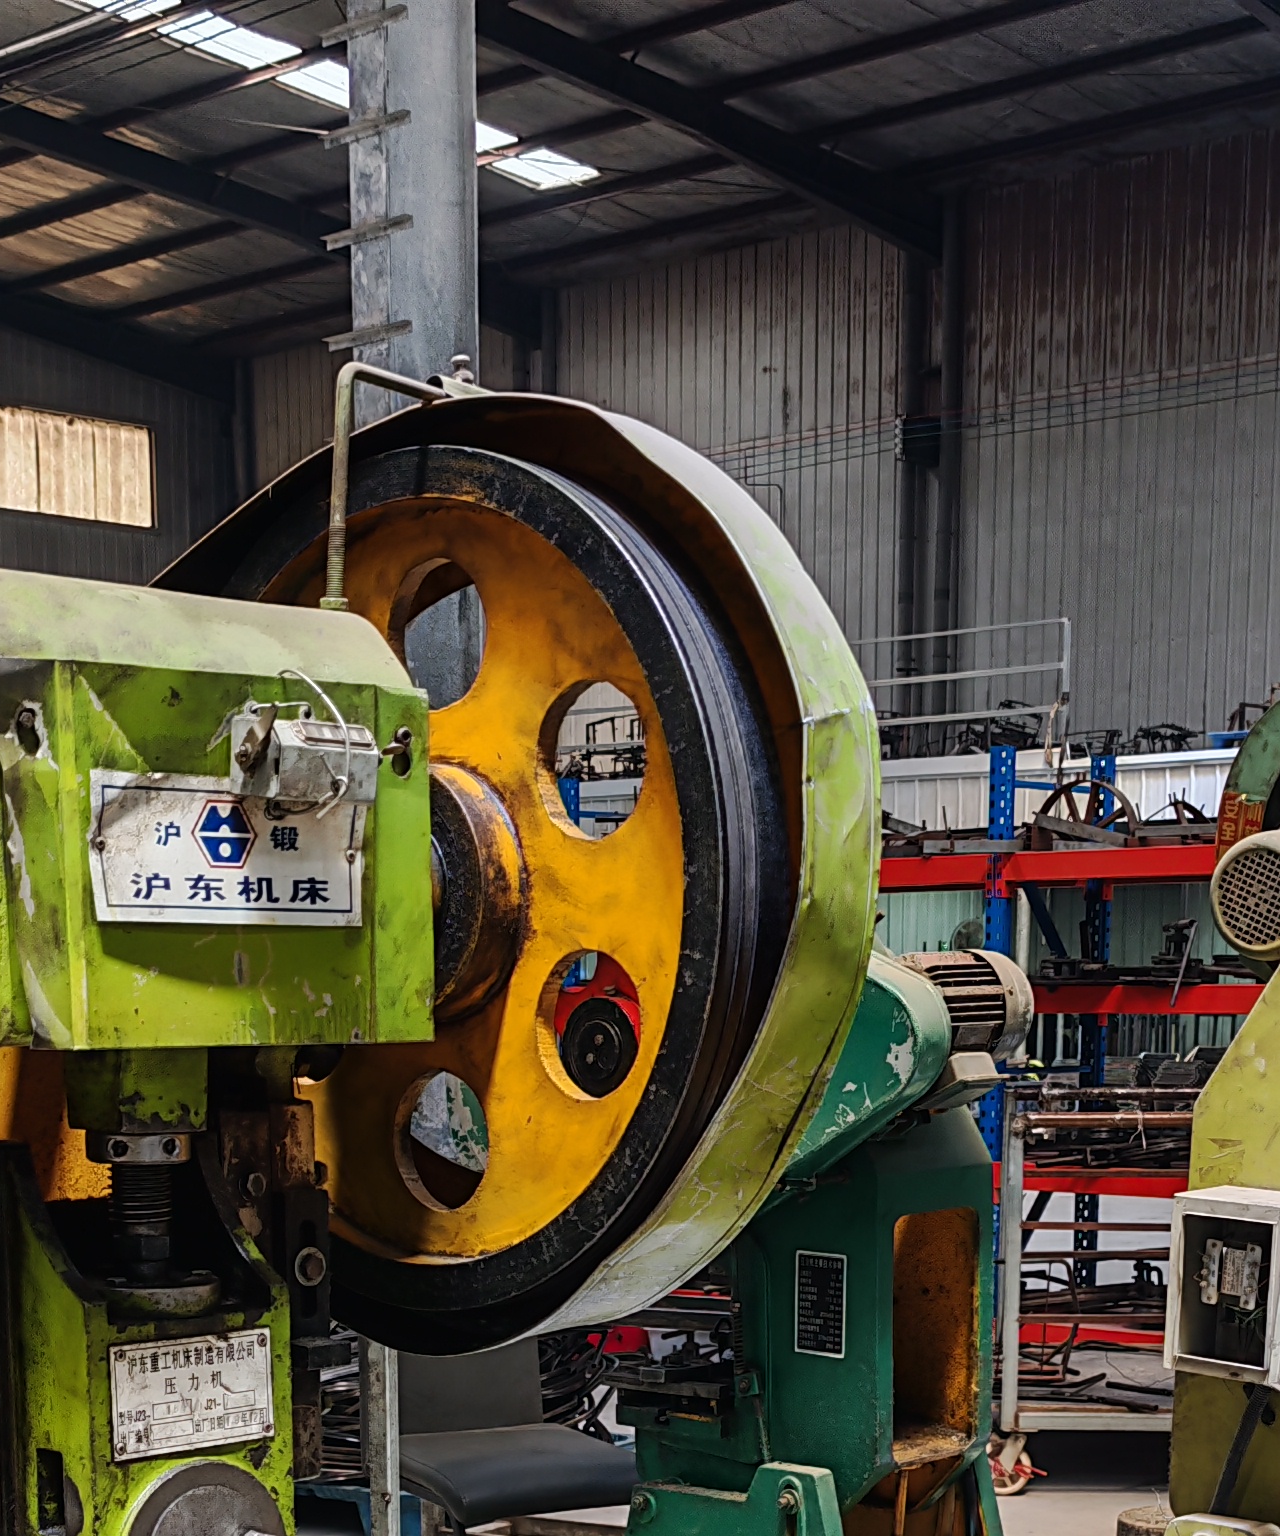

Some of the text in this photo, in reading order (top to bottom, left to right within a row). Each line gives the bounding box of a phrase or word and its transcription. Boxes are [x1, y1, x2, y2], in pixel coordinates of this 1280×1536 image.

[154, 820, 300, 852] 沪 锻
[129, 872, 331, 906] 沪东机床
[127, 1341, 255, 1376] 沪东重工机床制造有限公司
[164, 1370, 223, 1396] 压力机
